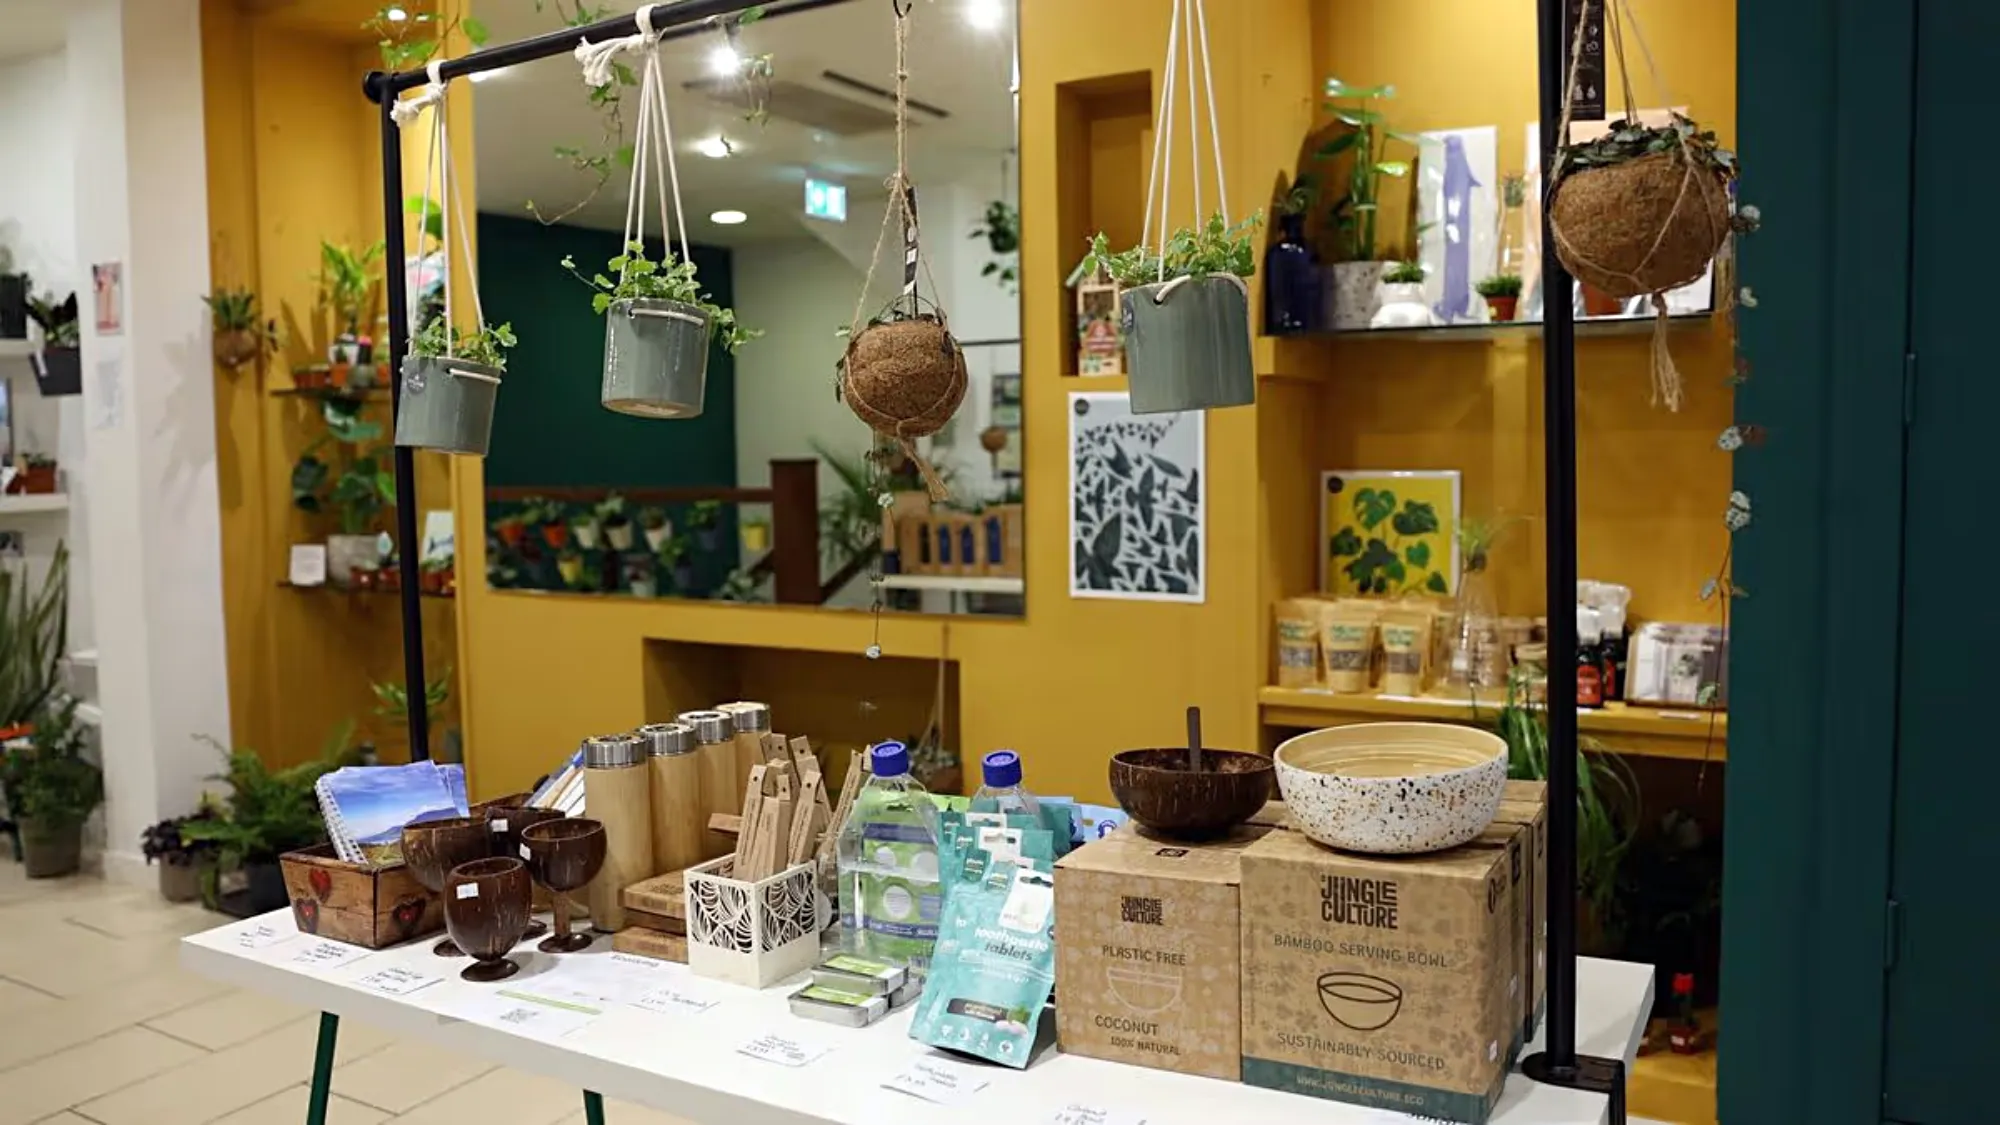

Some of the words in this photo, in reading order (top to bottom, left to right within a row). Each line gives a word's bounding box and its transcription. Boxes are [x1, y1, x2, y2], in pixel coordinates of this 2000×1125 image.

[1321, 874, 1397, 906] JUNGLE
[1121, 896, 1162, 911] JUNGLE
[1321, 900, 1398, 929] CULTURE
[1121, 910, 1164, 926] CULTURE
[1102, 944, 1153, 962] PLASTIC
[1156, 950, 1187, 966] FREE
[1274, 934, 1334, 954] BAMBOO
[1338, 943, 1402, 962] SERVING
[1407, 952, 1448, 968] BOWL
[1095, 1014, 1159, 1035] COCONUT
[1110, 1036, 1134, 1050] 100%
[1137, 1040, 1181, 1055] NATURAL
[1278, 1032, 1373, 1058] SUSTAINABLY
[1377, 1050, 1446, 1070] SOURCED
